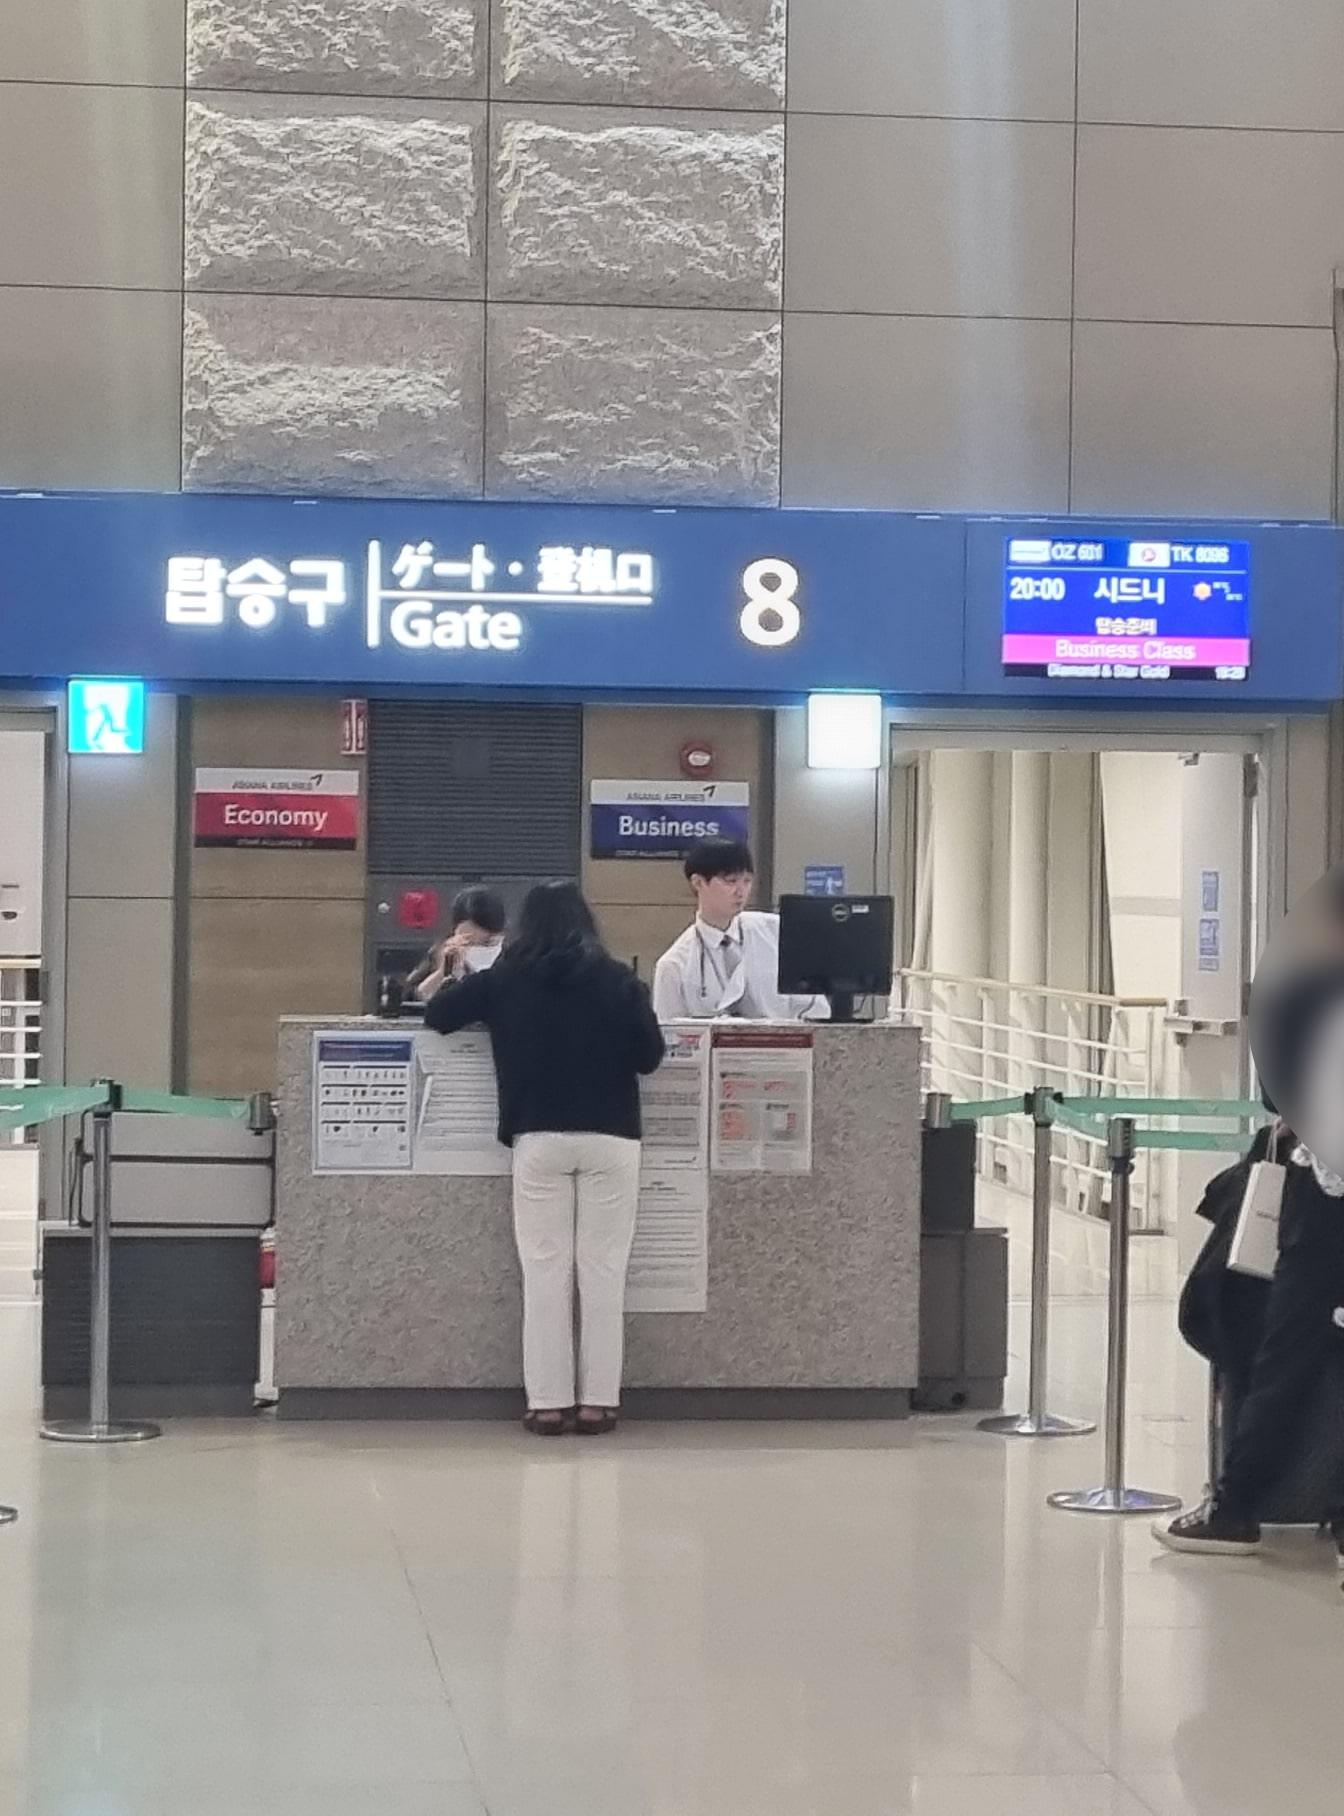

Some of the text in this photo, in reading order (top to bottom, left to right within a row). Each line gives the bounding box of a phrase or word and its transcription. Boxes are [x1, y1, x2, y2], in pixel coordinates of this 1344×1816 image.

[1051, 543, 1103, 561] OZ 601
[1171, 545, 1194, 562] TK
[166, 556, 347, 628] 탑승구
[1010, 576, 1065, 600] 20:00
[1094, 576, 1166, 605] 시드니
[739, 557, 801, 646] 8
[390, 600, 523, 651] Gate
[1095, 616, 1157, 636] 탑승준비
[1056, 639, 1196, 660] Business Class
[224, 804, 328, 831] Economy
[619, 815, 719, 837] Business
